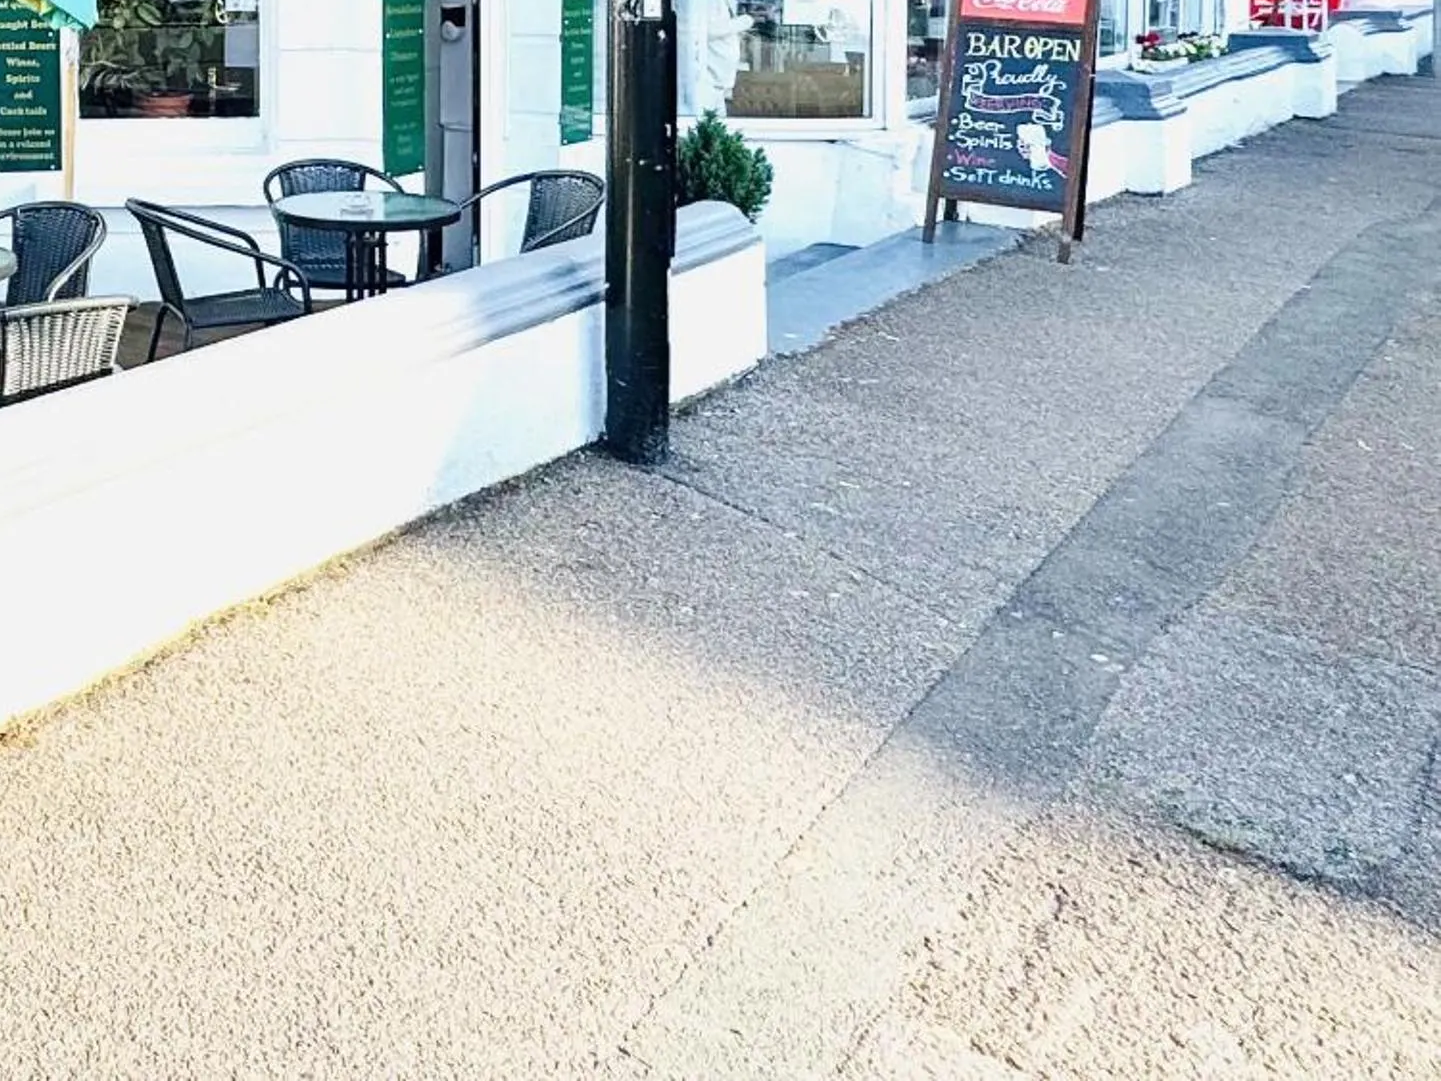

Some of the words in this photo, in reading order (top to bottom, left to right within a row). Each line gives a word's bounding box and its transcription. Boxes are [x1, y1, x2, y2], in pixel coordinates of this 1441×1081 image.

[965, 32, 1022, 58] BAR
[1024, 36, 1080, 62] OPEN
[964, 59, 1067, 97] Proudly
[959, 112, 1005, 132] Beer
